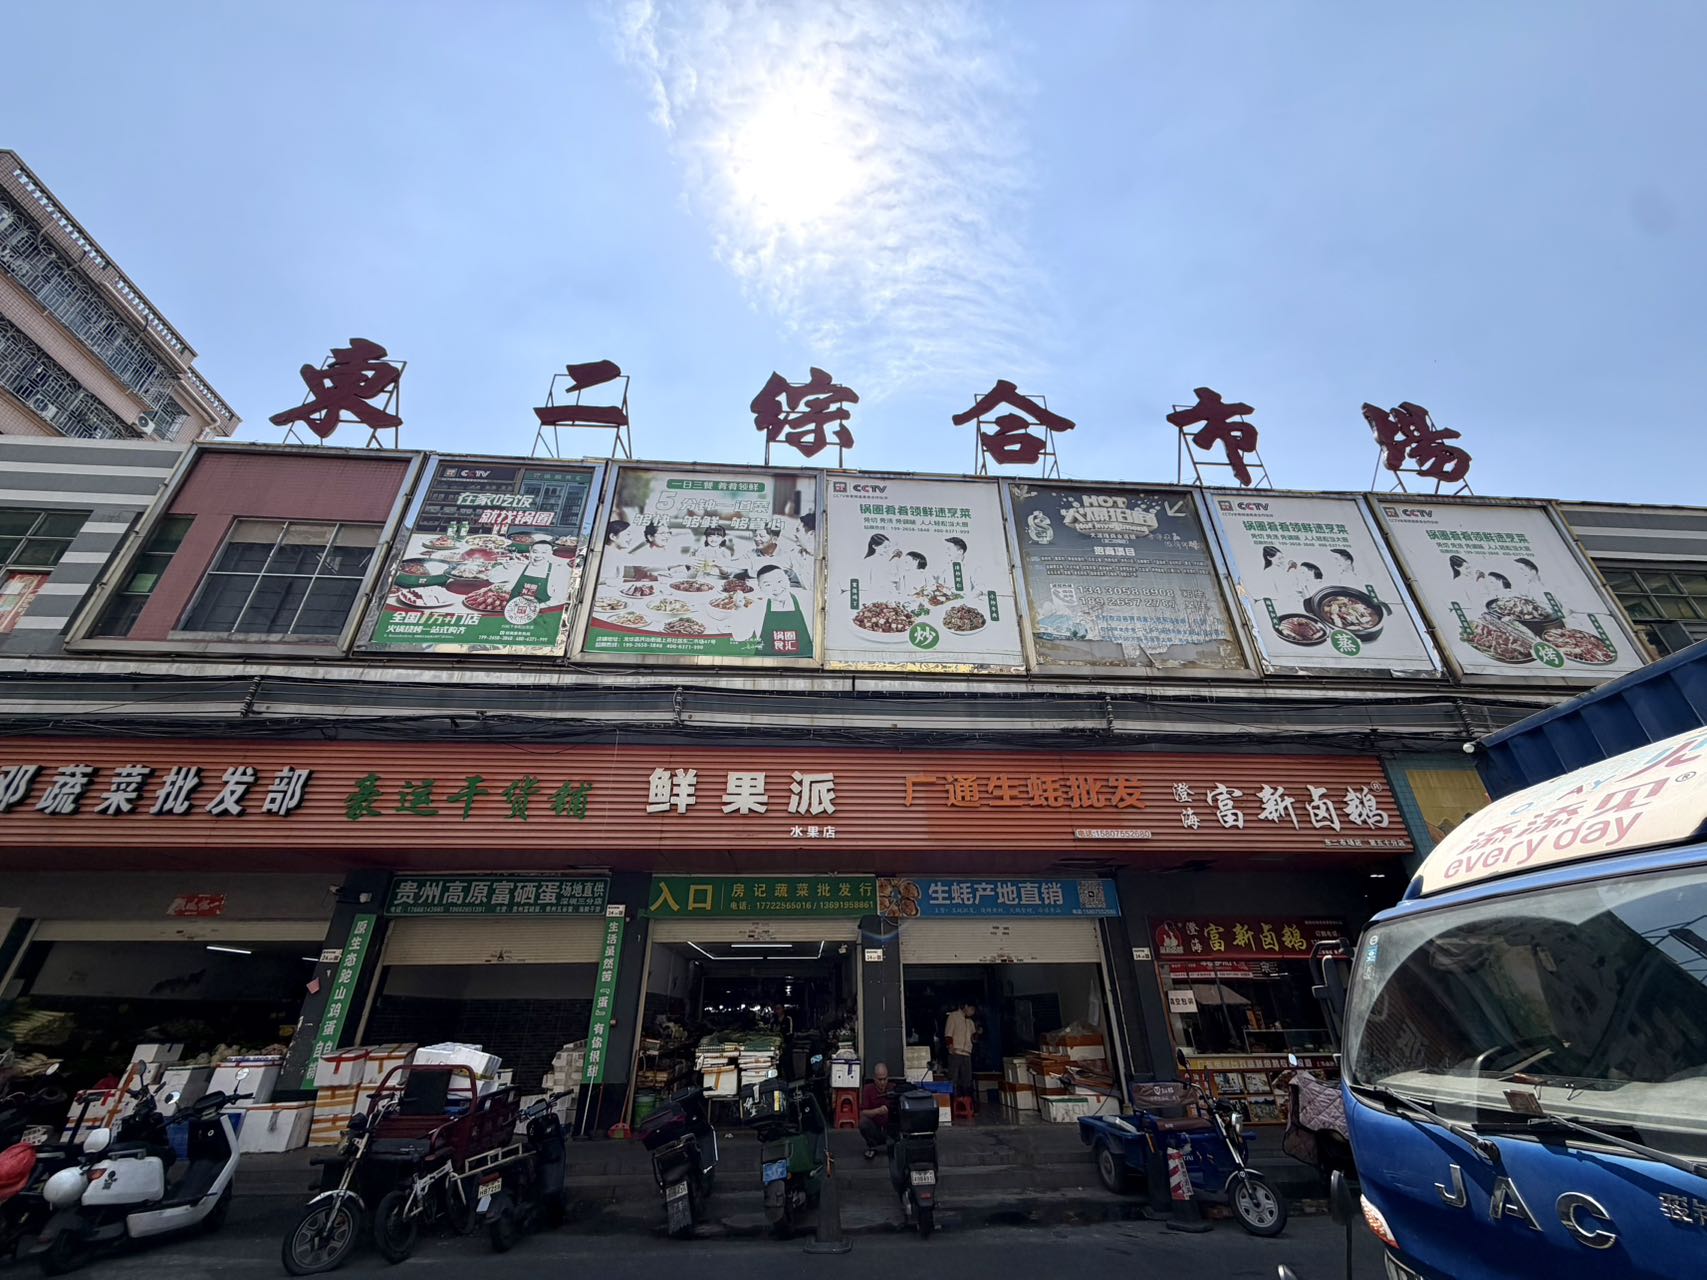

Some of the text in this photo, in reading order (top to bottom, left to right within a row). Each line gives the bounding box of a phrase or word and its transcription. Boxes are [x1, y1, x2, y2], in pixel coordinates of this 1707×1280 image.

[460, 469, 492, 478] CCTV
[852, 484, 887, 493] CCTV
[456, 491, 535, 508] 在家吃饭
[655, 491, 770, 514] 5分钟一道菜
[1082, 495, 1128, 508] HOT
[1237, 502, 1269, 511] CCTV
[478, 508, 555, 526] 就找锅圈
[1402, 509, 1433, 518] CCTV
[1077, 586, 1101, 595] 134
[1106, 587, 1139, 596] 3058
[1081, 597, 1104, 606] 189
[1108, 598, 1141, 607] 2657
[389, 611, 482, 626] 全国1万+门店
[773, 631, 796, 641] 锅圈
[914, 626, 936, 647] 炒
[1334, 633, 1357, 653] 蒸
[774, 640, 797, 651] 食汇
[1539, 645, 1560, 665] 烤
[646, 767, 837, 815] 鲜果派
[904, 773, 1148, 809] 广通生蚝批发
[790, 826, 837, 840] 水果店
[1444, 811, 1645, 880] every day
[393, 881, 561, 905] 贵州高原富硒蛋
[559, 881, 605, 898] 场地直供
[650, 882, 714, 912] 入口
[731, 882, 873, 898] 房记蔬菜批发行
[928, 882, 1064, 905] 生蚝产地直销
[1434, 1163, 1617, 1249] JAC
